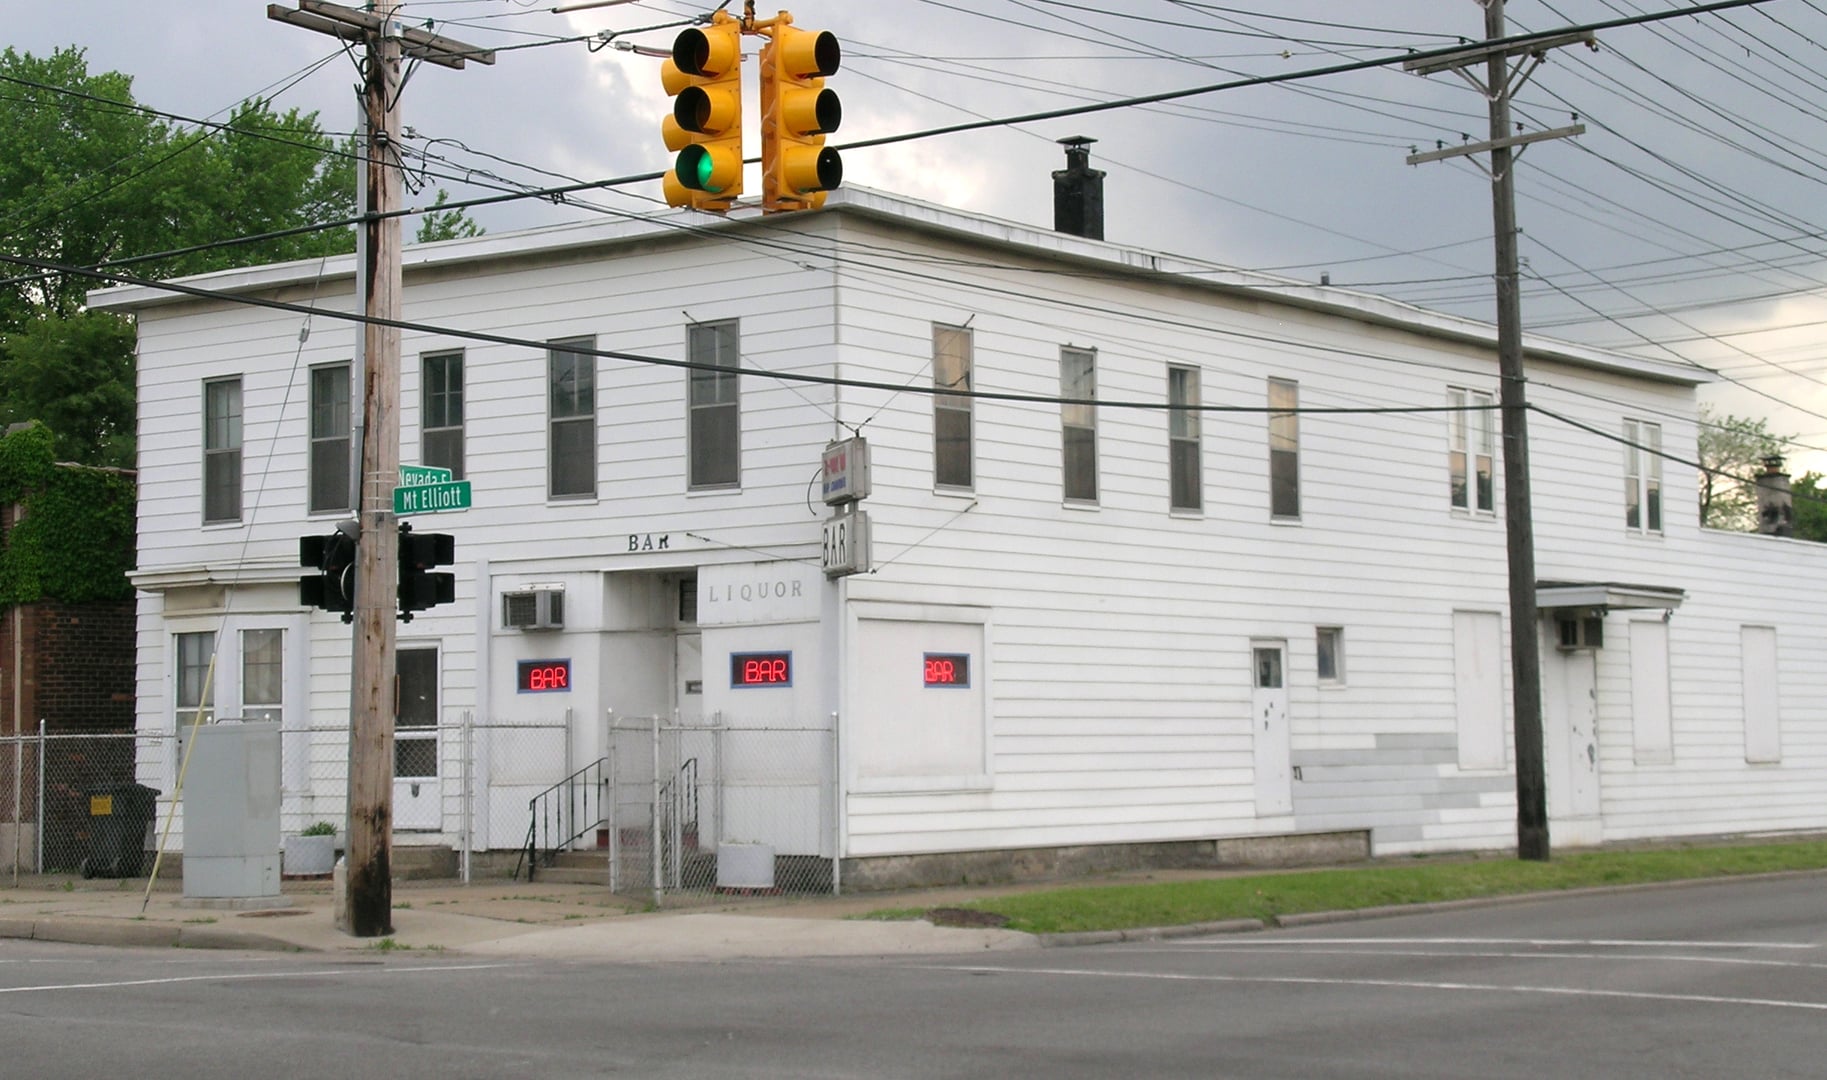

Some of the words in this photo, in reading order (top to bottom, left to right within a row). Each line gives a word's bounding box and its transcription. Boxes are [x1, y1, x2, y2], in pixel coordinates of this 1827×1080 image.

[399, 469, 438, 486] Nevada
[403, 490, 417, 510] Mt
[421, 486, 461, 509] Elliott
[628, 534, 669, 551] BAR
[823, 523, 846, 567] BAR
[709, 580, 802, 602] LIQUOR
[530, 666, 566, 690] BAR
[745, 660, 786, 682] BAR
[925, 660, 954, 682] BAR
